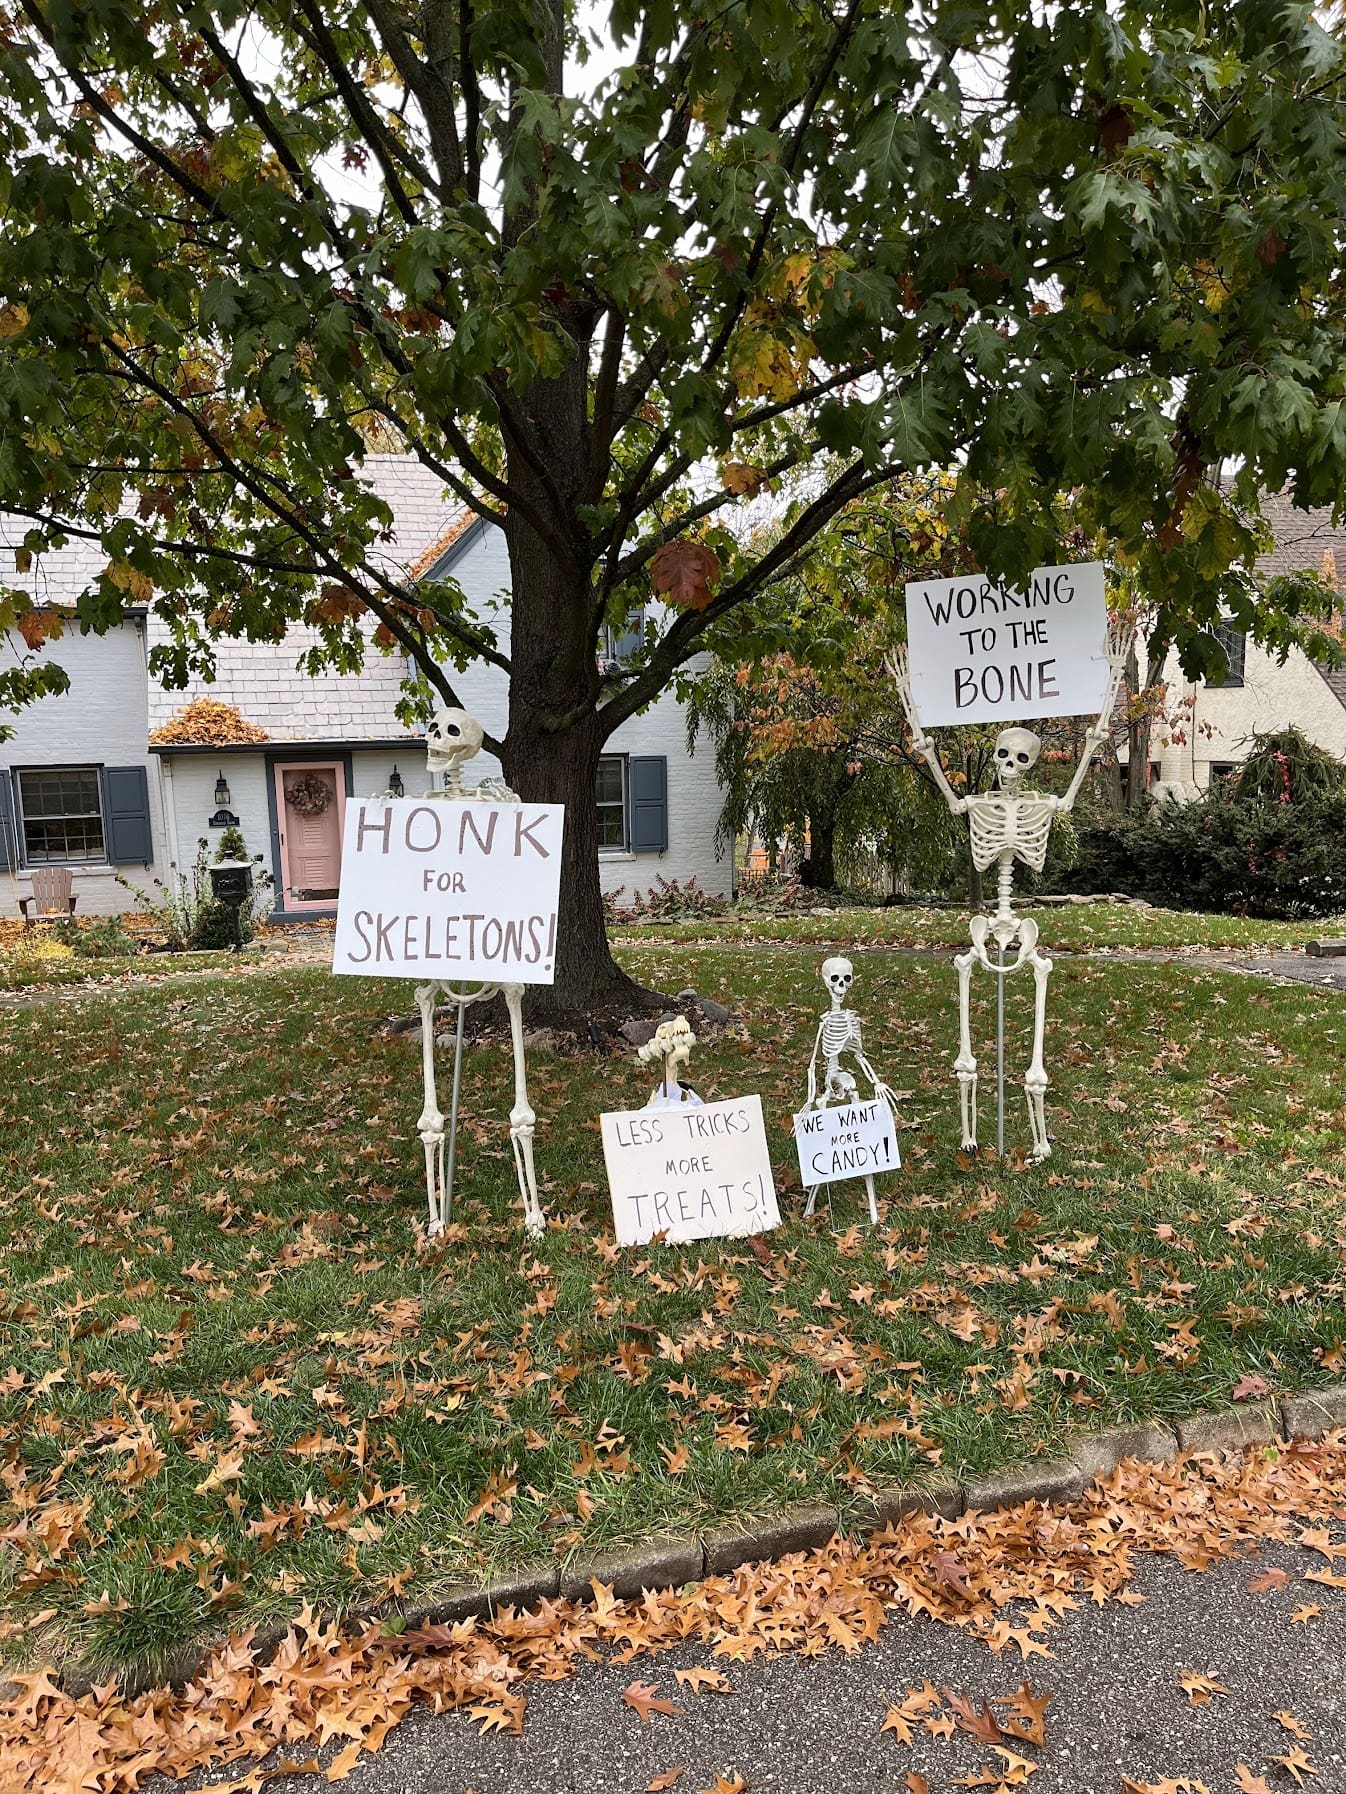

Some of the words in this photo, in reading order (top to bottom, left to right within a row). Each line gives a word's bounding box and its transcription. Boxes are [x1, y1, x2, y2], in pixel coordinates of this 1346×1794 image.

[924, 574, 1075, 626] WORKING
[960, 627, 996, 655] TO
[1005, 619, 1048, 648] THE
[954, 658, 1060, 708] BONE
[357, 806, 550, 858] HONK
[423, 869, 467, 893] FOR
[347, 910, 556, 971] SKELETONS!
[616, 1119, 663, 1147] LESS
[683, 1110, 750, 1139] TRICKS
[802, 1114, 824, 1134] WE
[837, 1104, 878, 1128] WANT
[812, 1137, 890, 1174] CANDY!
[831, 1132, 860, 1146] MORE
[665, 1156, 713, 1175] MORE
[627, 1174, 768, 1228] TREATS!
